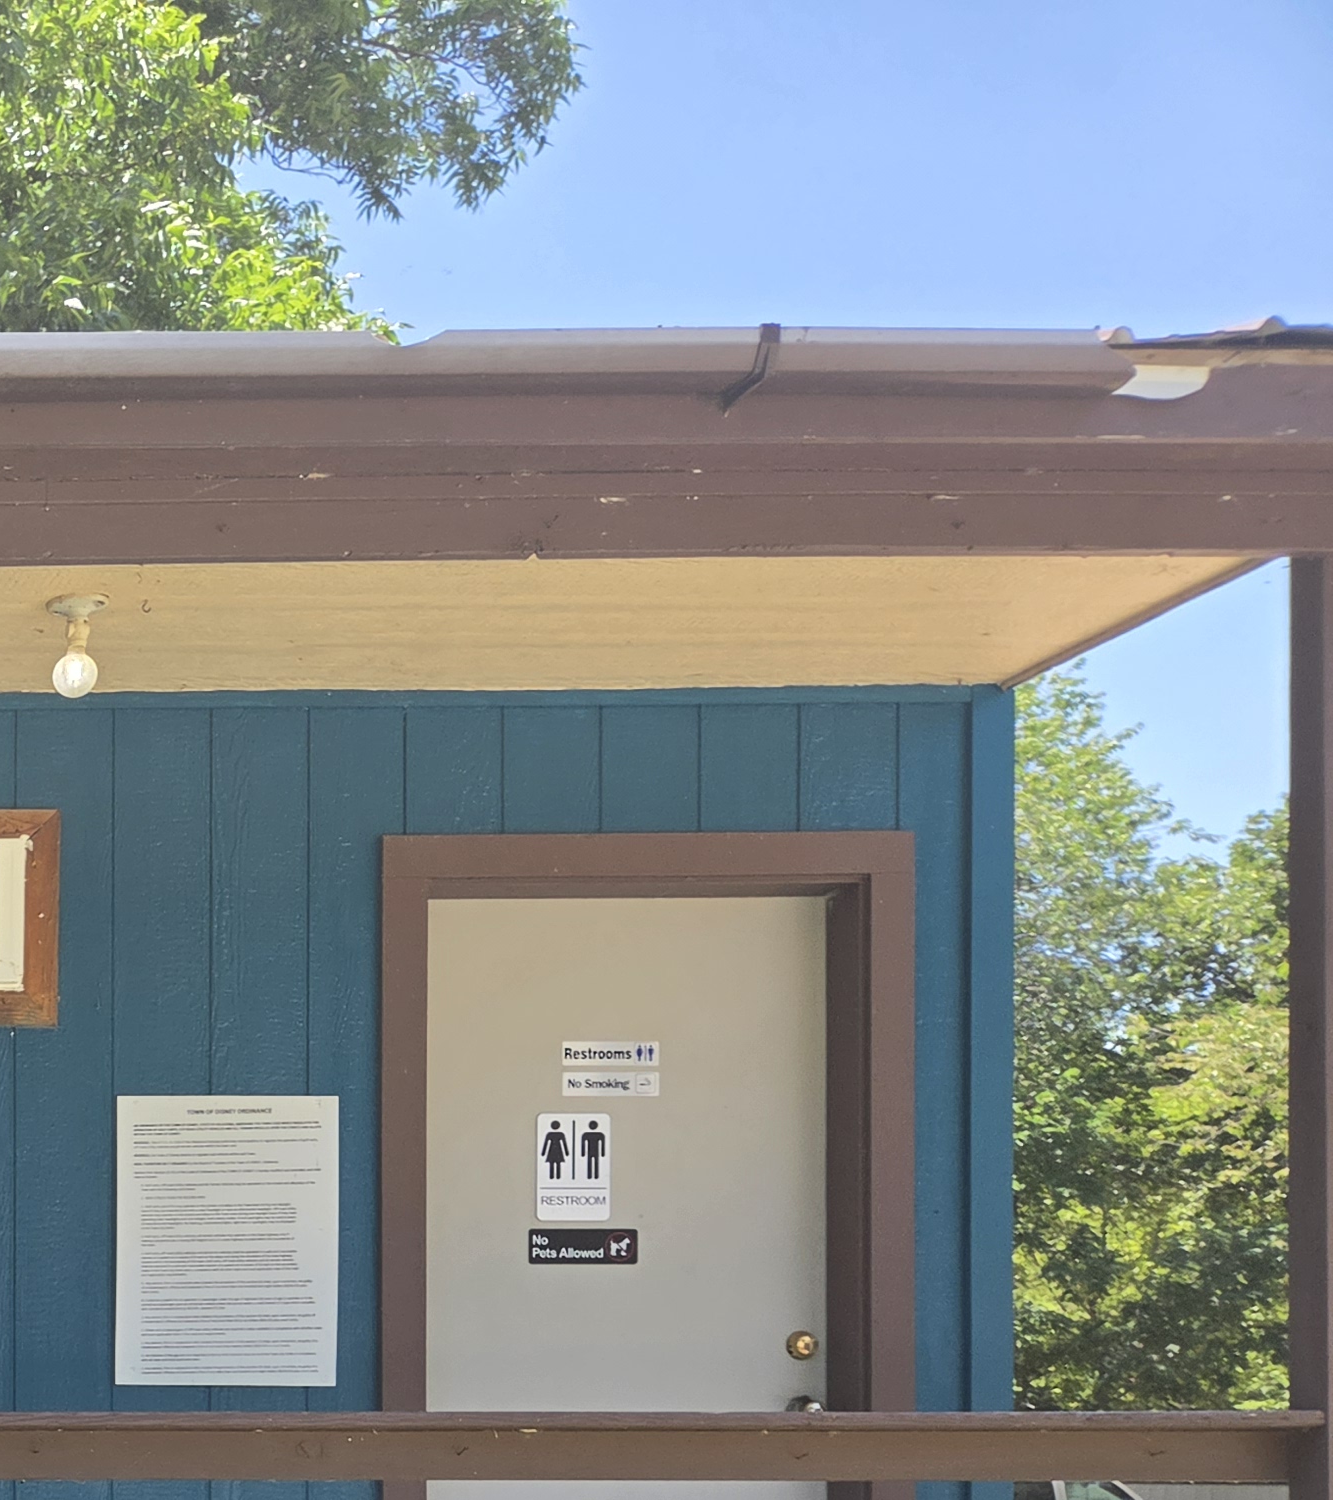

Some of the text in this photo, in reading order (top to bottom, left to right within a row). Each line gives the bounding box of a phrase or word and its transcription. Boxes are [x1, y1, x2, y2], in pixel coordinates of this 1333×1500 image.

[564, 1048, 632, 1060] Restrooms
[567, 1078, 630, 1091] No Smoking
[541, 1195, 606, 1206] RESTROOM
[532, 1234, 549, 1246] No
[532, 1247, 604, 1258] Pets Allowed
